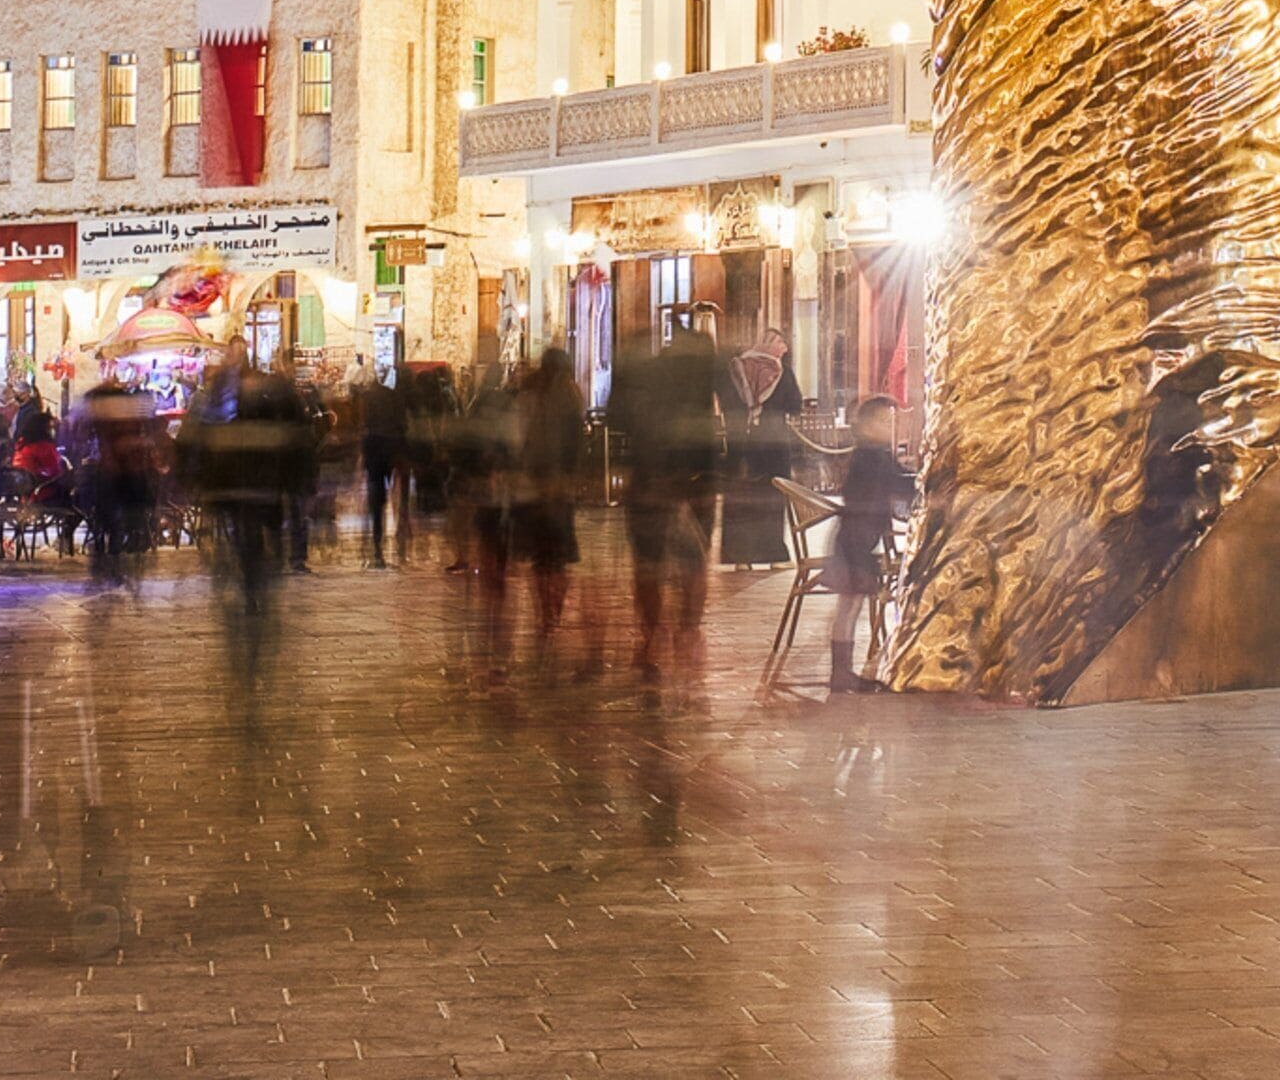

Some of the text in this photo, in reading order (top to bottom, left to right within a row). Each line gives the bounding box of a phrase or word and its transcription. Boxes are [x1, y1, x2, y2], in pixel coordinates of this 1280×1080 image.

[81, 211, 331, 246] متجر الخليفي والقحطاني
[213, 238, 278, 250] KHELAIFI
